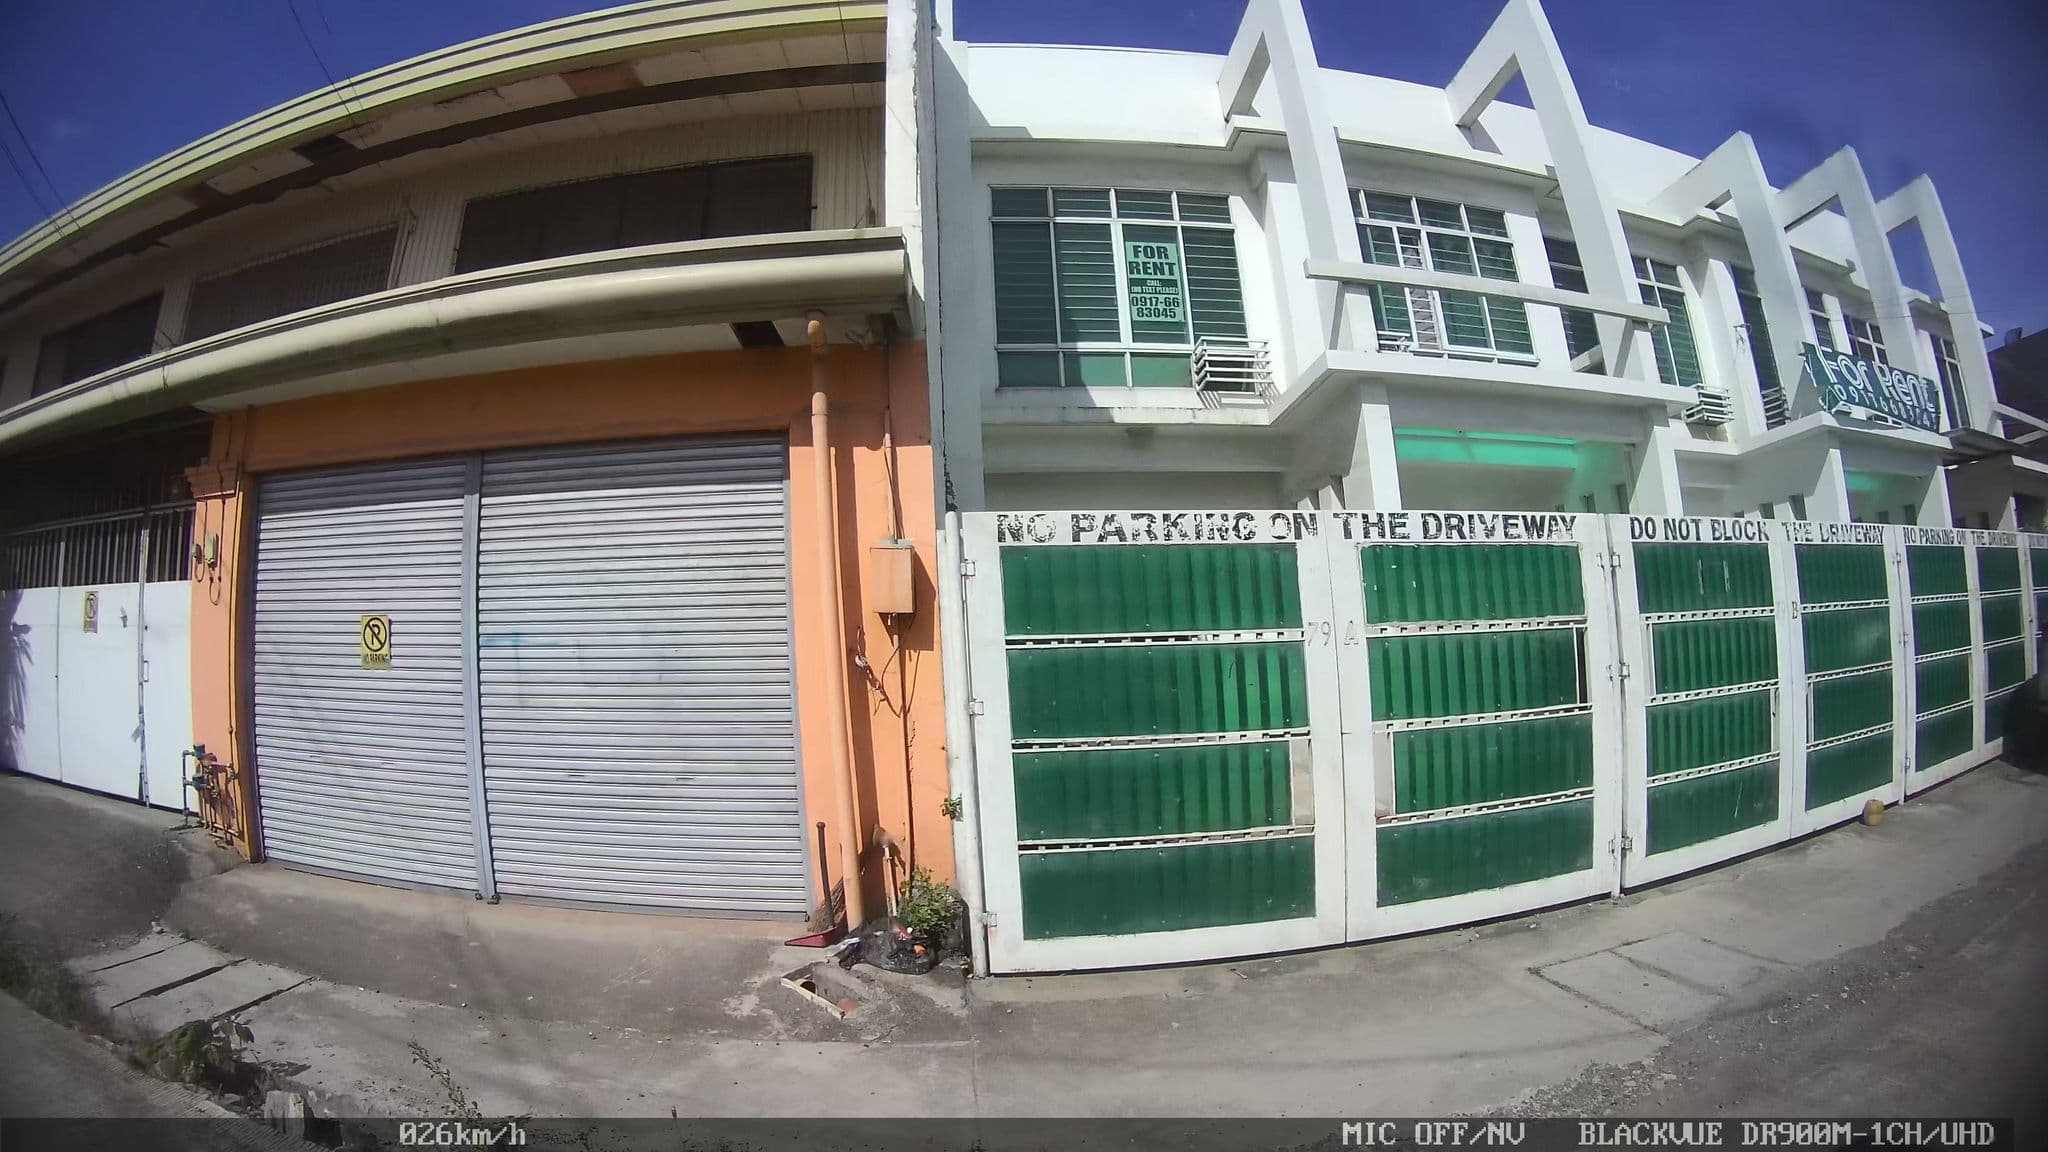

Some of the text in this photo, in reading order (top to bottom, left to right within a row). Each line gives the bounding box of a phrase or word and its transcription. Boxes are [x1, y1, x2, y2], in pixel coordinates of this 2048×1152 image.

[1132, 245, 1169, 260] FOR
[1128, 261, 1176, 276] RENT
[1131, 296, 1180, 308] 0917-66
[1136, 307, 1176, 318] 83045
[1814, 345, 1936, 412] For Rent
[996, 512, 1577, 543] NO PARKING ON THE DRIVEWAY
[1629, 517, 1657, 540] DO
[1664, 518, 1702, 541] NOT
[1710, 519, 1770, 541] BLOCK
[1782, 521, 1814, 542] THE
[1903, 527, 1916, 544] NO
[1919, 528, 1954, 545] PARKING
[1972, 531, 1985, 545] THE
